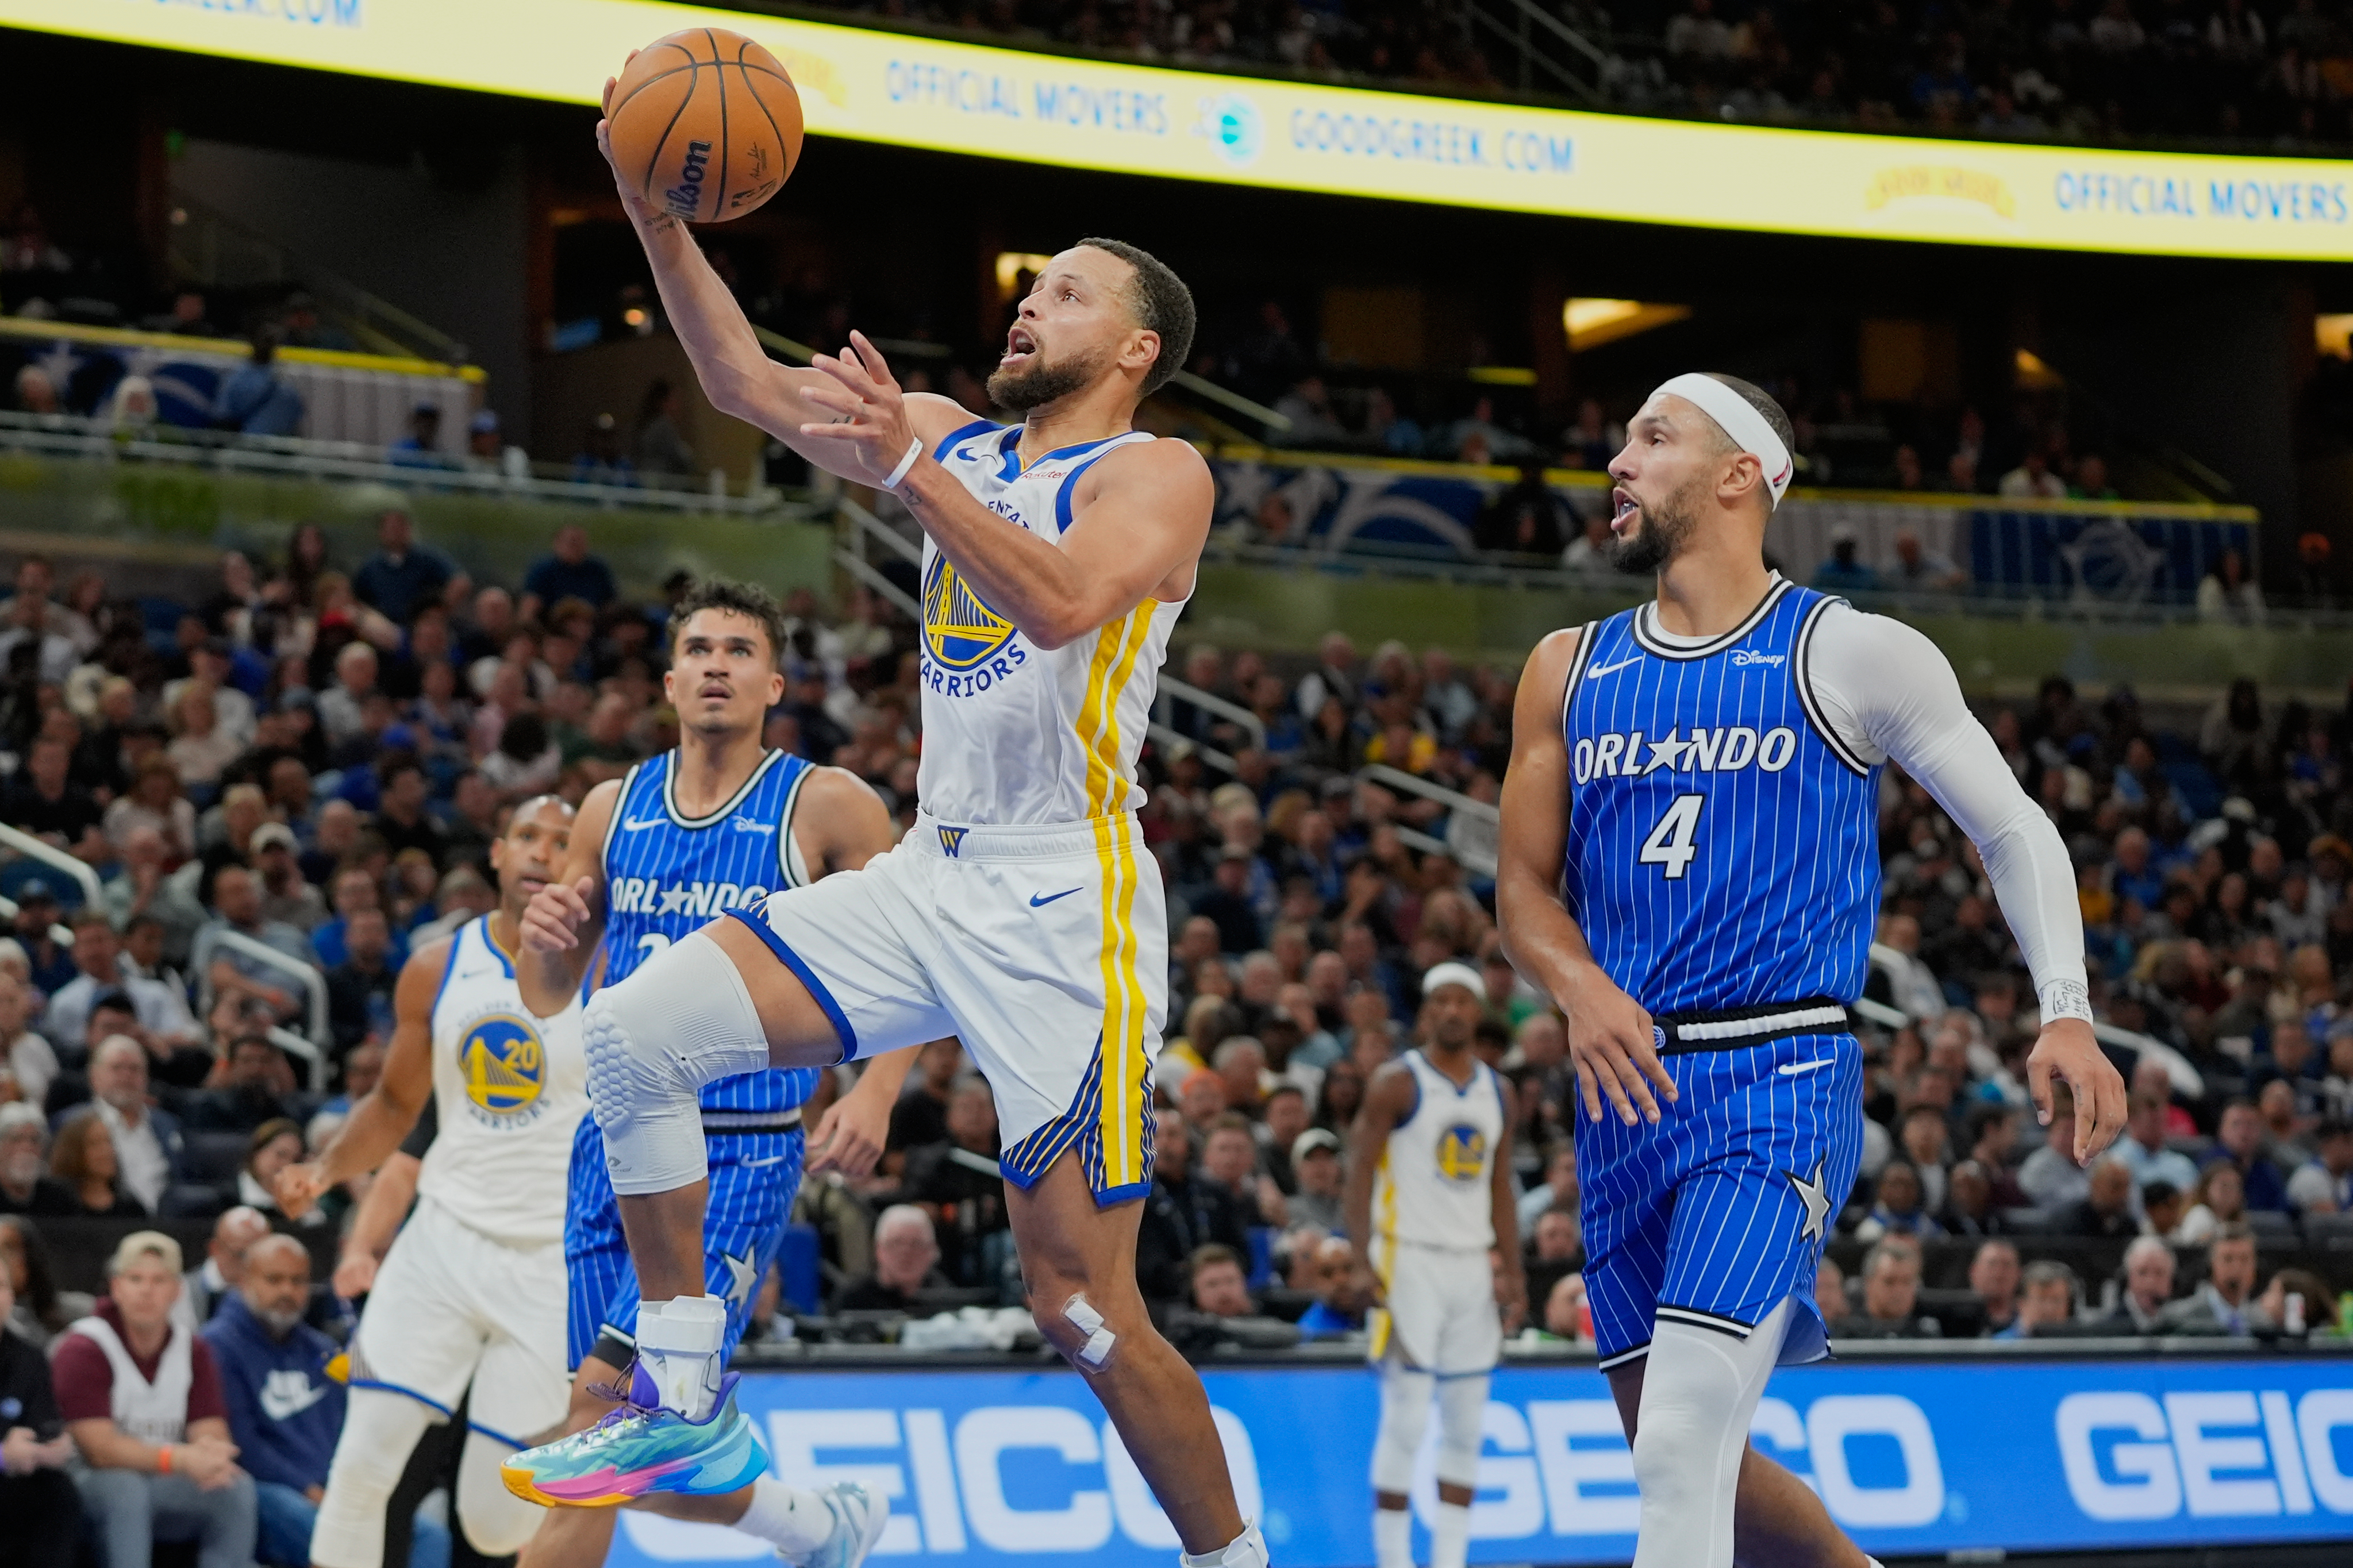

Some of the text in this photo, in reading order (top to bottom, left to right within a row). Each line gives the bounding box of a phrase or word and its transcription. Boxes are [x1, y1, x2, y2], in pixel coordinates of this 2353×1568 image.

[887, 61, 1022, 117] OFFICIAL
[1035, 83, 1169, 136] MOVERS
[1290, 109, 1575, 173] GOODGREEK.COM
[2056, 173, 2348, 223] OFFICIAL MOVERS
[1639, 792, 1705, 880] 4
[503, 1038, 539, 1071] 20
